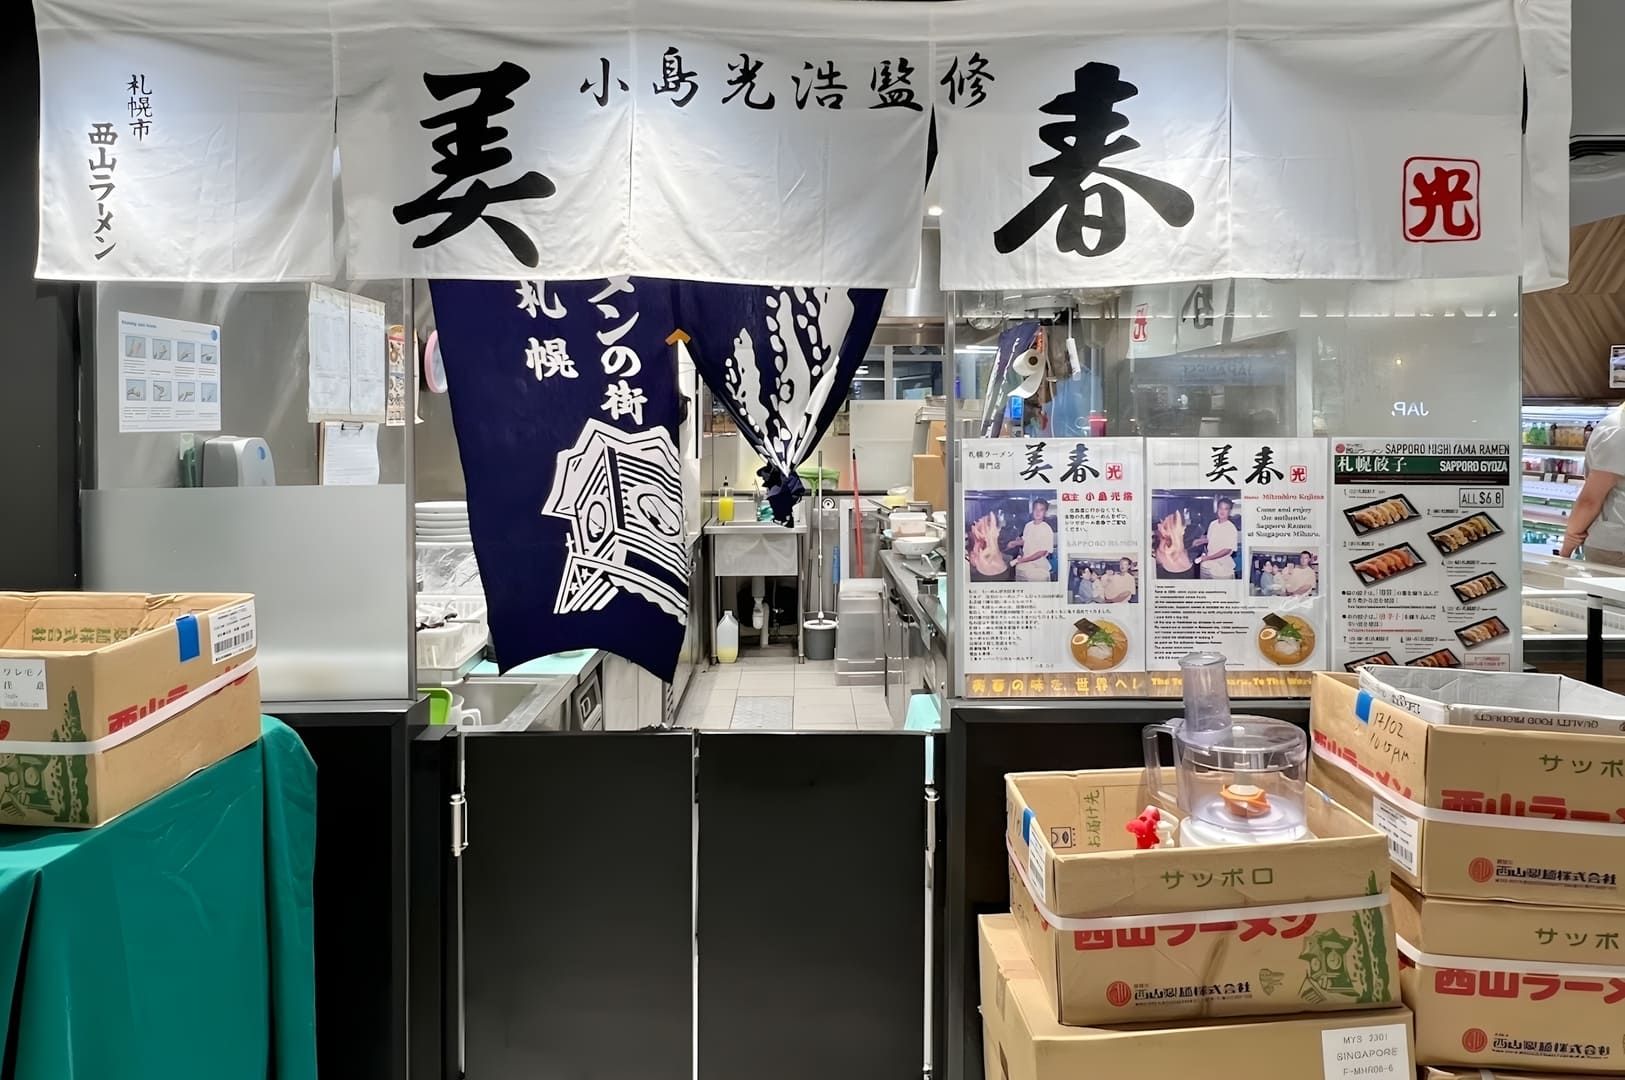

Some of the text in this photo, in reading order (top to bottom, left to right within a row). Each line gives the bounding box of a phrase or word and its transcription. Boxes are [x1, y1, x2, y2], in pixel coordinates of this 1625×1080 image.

[580, 46, 996, 111] 小島光浩監修
[127, 73, 153, 141] 札幌市
[392, 61, 1195, 267] 美 春
[88, 122, 118, 260] 西山ラーメン
[1408, 165, 1475, 238] 光
[1019, 441, 1100, 484] 美春
[1205, 444, 1284, 485] 美春
[1385, 443, 1425, 454] SAPPORO
[1479, 444, 1510, 455] RAMEN
[1439, 460, 1508, 472] SAPPORO GYOZA
[1461, 493, 1477, 505] ALL
[1526, 716, 1554, 727] FOOD
[1160, 866, 1274, 890] サッポロ
[1336, 1047, 1398, 1061] SINGAPORE
